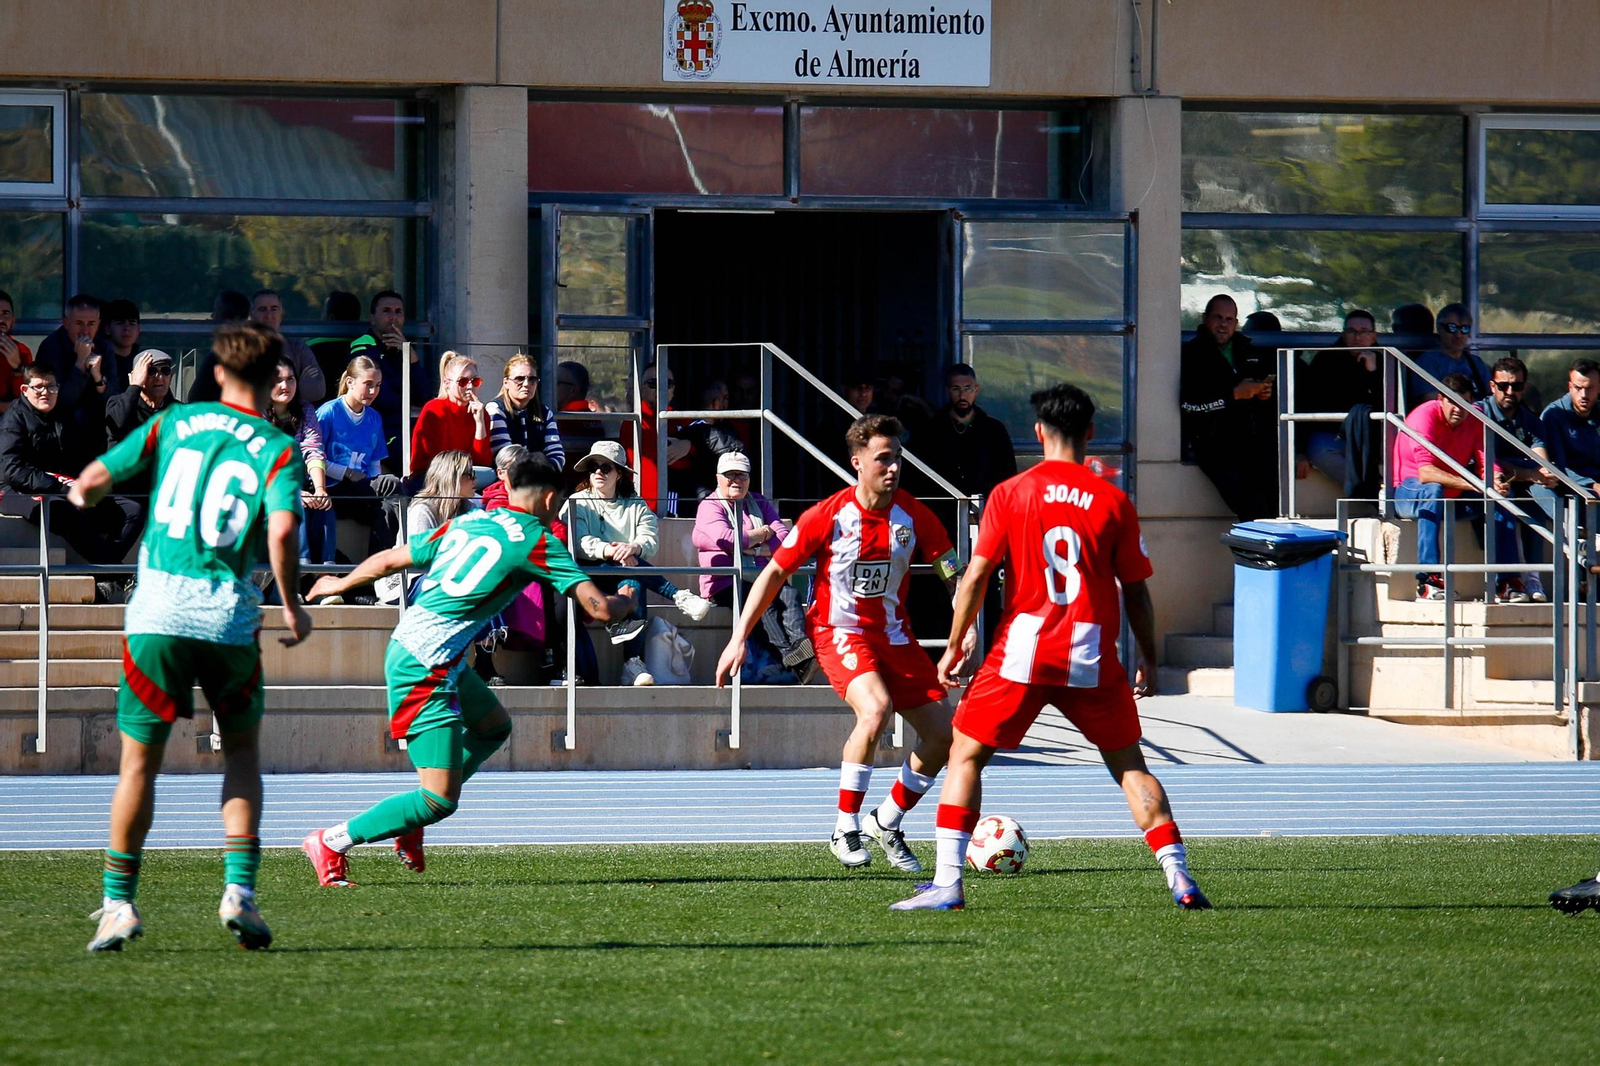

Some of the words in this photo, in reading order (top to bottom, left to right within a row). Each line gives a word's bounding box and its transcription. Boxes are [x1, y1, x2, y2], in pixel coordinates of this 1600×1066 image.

[731, 3, 817, 33] Excmo.
[822, 4, 985, 41] Ayuntamiento
[795, 49, 821, 78] de
[827, 50, 921, 79] Almería
[175, 412, 255, 441] ANGELO
[154, 447, 259, 547] 46
[1043, 484, 1094, 511] JOAN
[421, 528, 502, 597] 20
[863, 568, 882, 579] DA
[1043, 526, 1081, 605] 8
[861, 580, 880, 591] ZN
